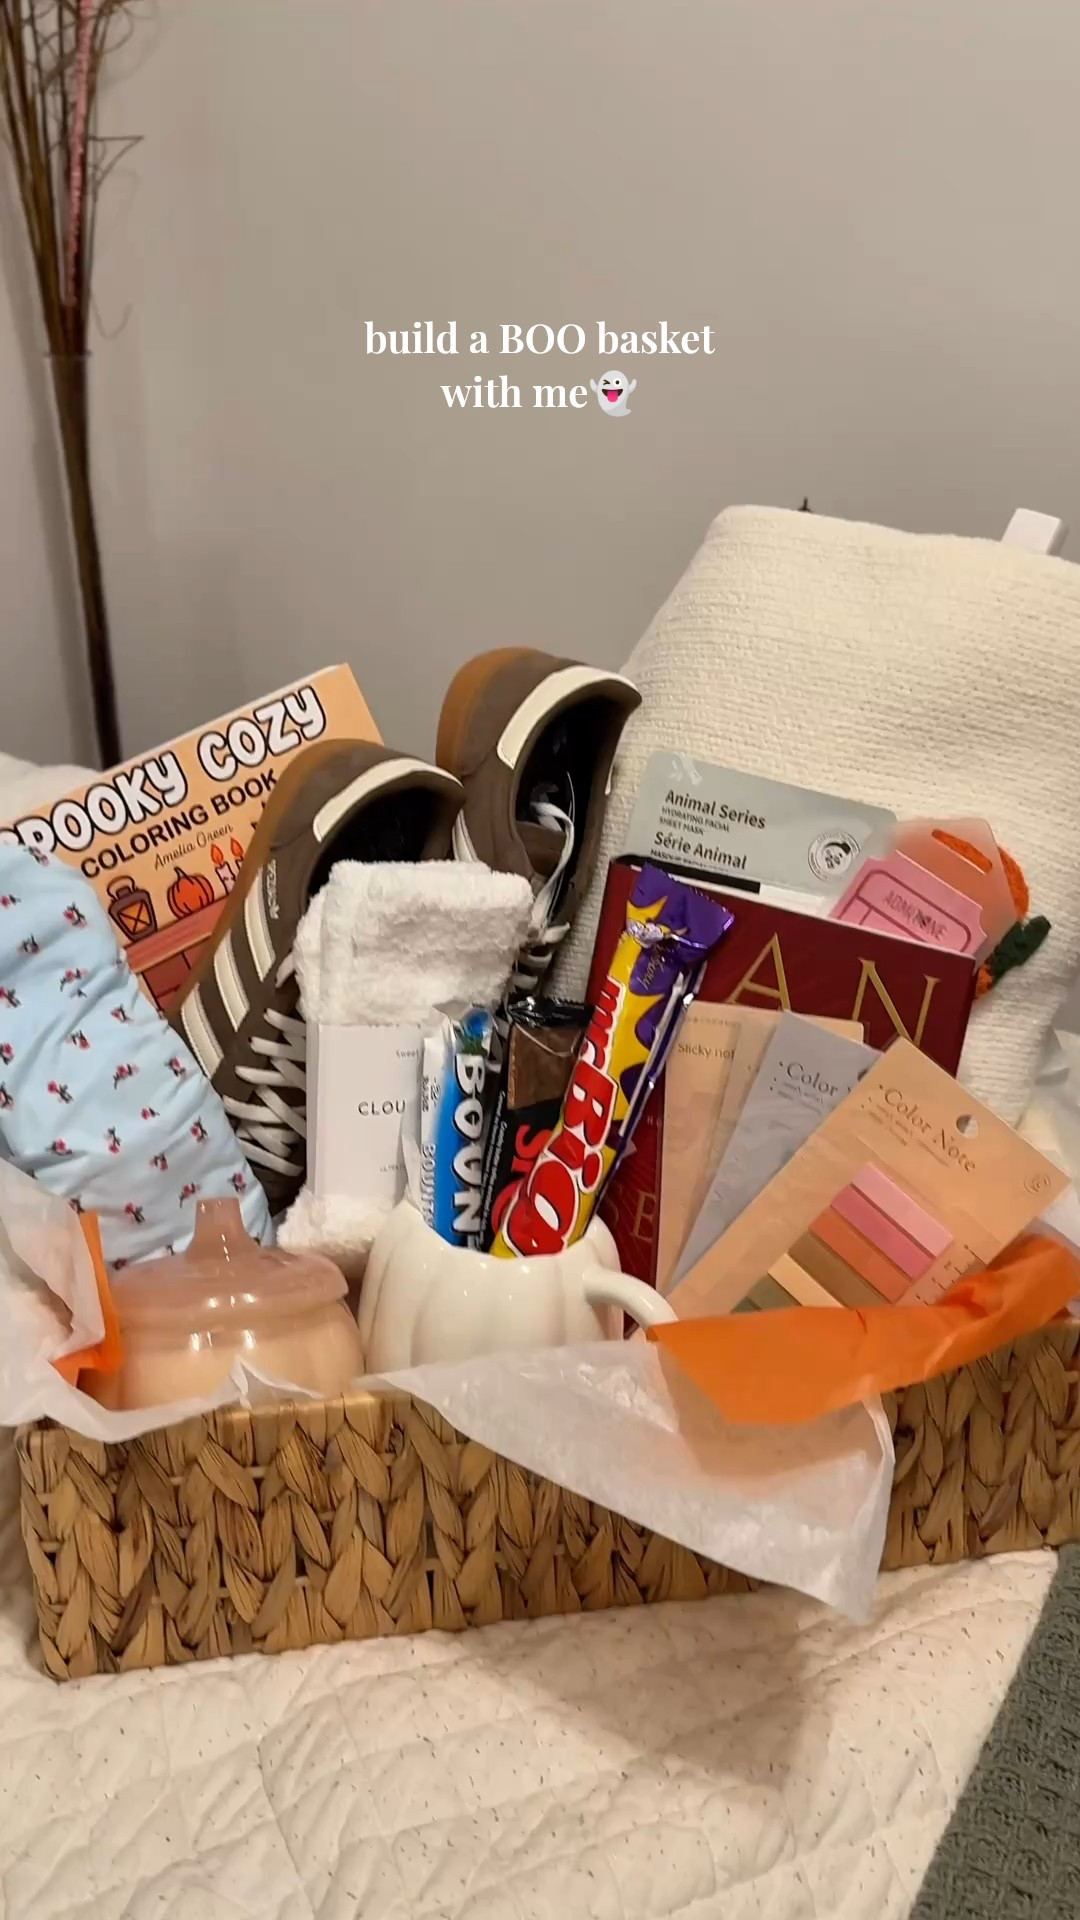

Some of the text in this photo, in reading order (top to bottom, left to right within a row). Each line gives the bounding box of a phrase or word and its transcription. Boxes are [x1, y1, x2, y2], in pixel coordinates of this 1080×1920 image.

[197, 685, 327, 781] COZY
[80, 768, 278, 879] COLORING BOOK
[665, 789, 766, 830] Animal Series
[154, 840, 197, 871] Amelia
[654, 830, 691, 854] Série
[692, 842, 748, 870] Animal
[678, 1043, 736, 1061] Sticky not
[787, 1061, 839, 1097] Color
[358, 1100, 406, 1116] CLOU
[452, 1053, 486, 1247] BOUN
[884, 1087, 932, 1133] Color
[932, 1128, 976, 1173] Note
